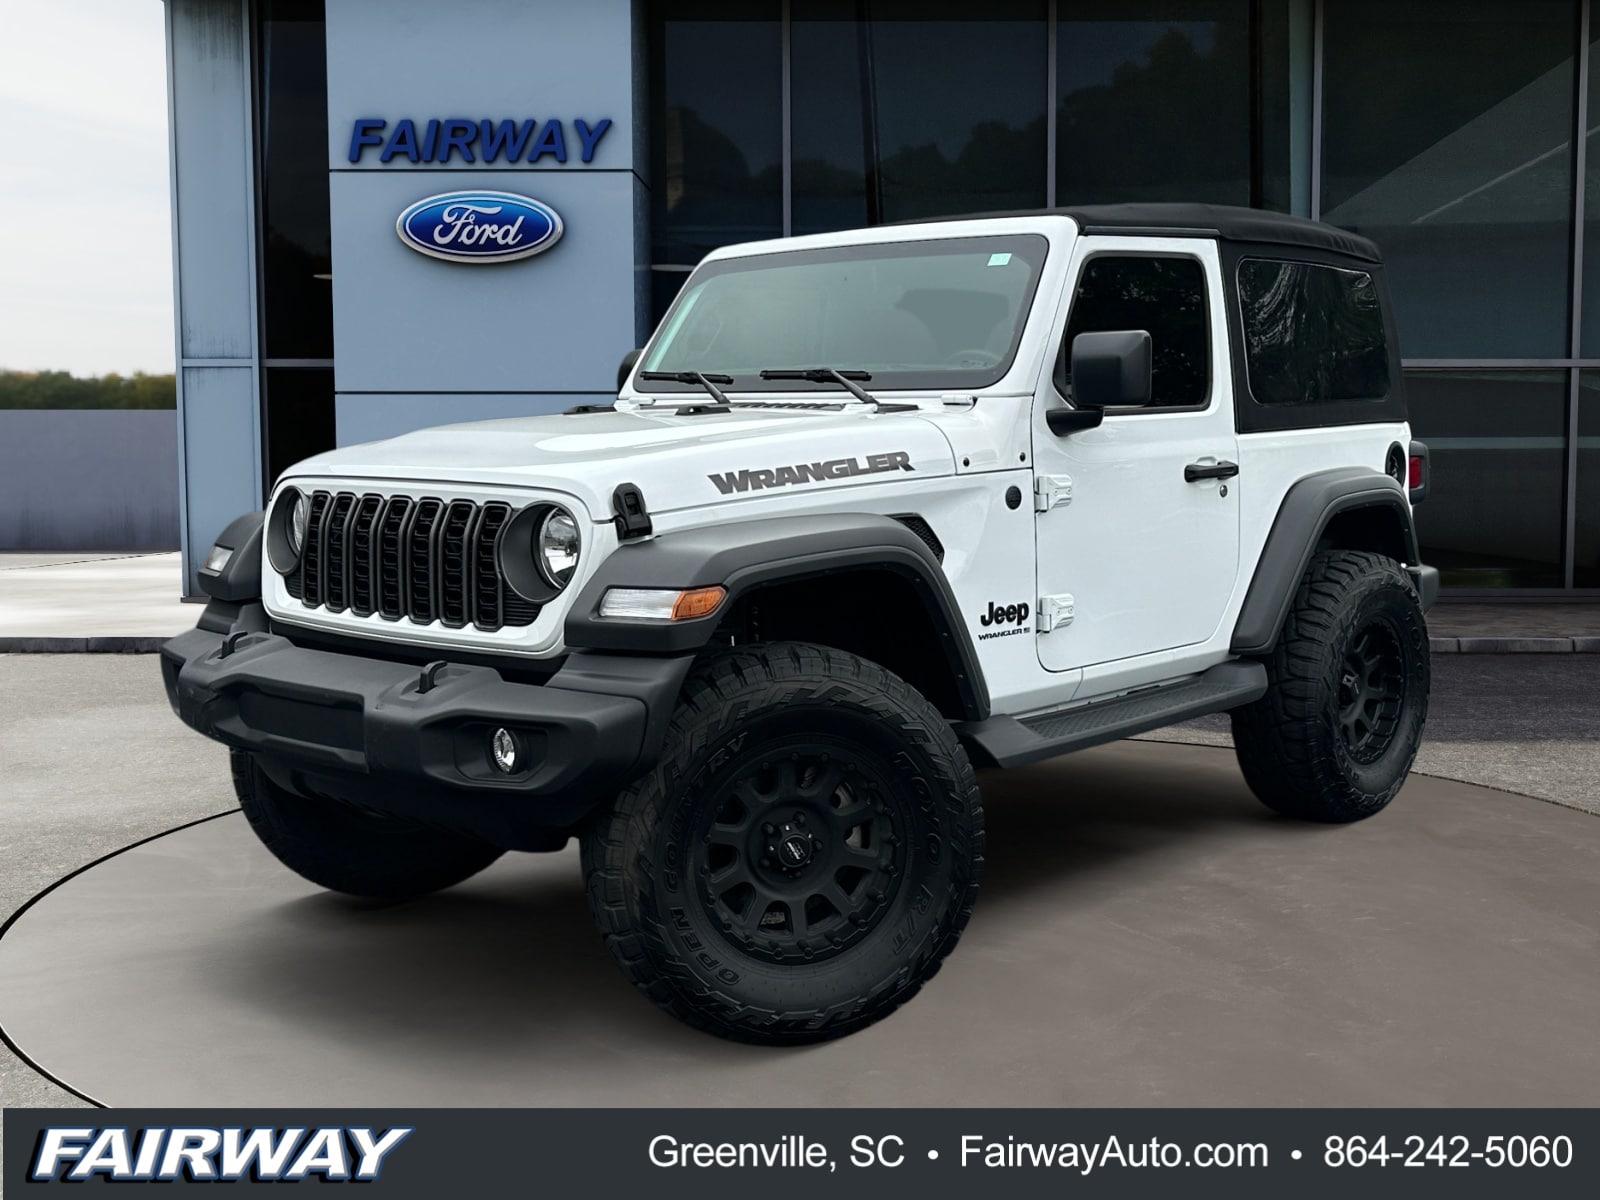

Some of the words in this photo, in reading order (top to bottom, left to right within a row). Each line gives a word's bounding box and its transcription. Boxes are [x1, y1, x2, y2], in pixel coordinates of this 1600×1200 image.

[348, 119, 613, 164] FAIRWAY
[432, 203, 526, 246] Ford
[707, 451, 916, 495] WRANGLER
[978, 628, 1023, 641] WRANGLER
[980, 601, 1030, 627] Jeep
[669, 906, 741, 986] OPEN
